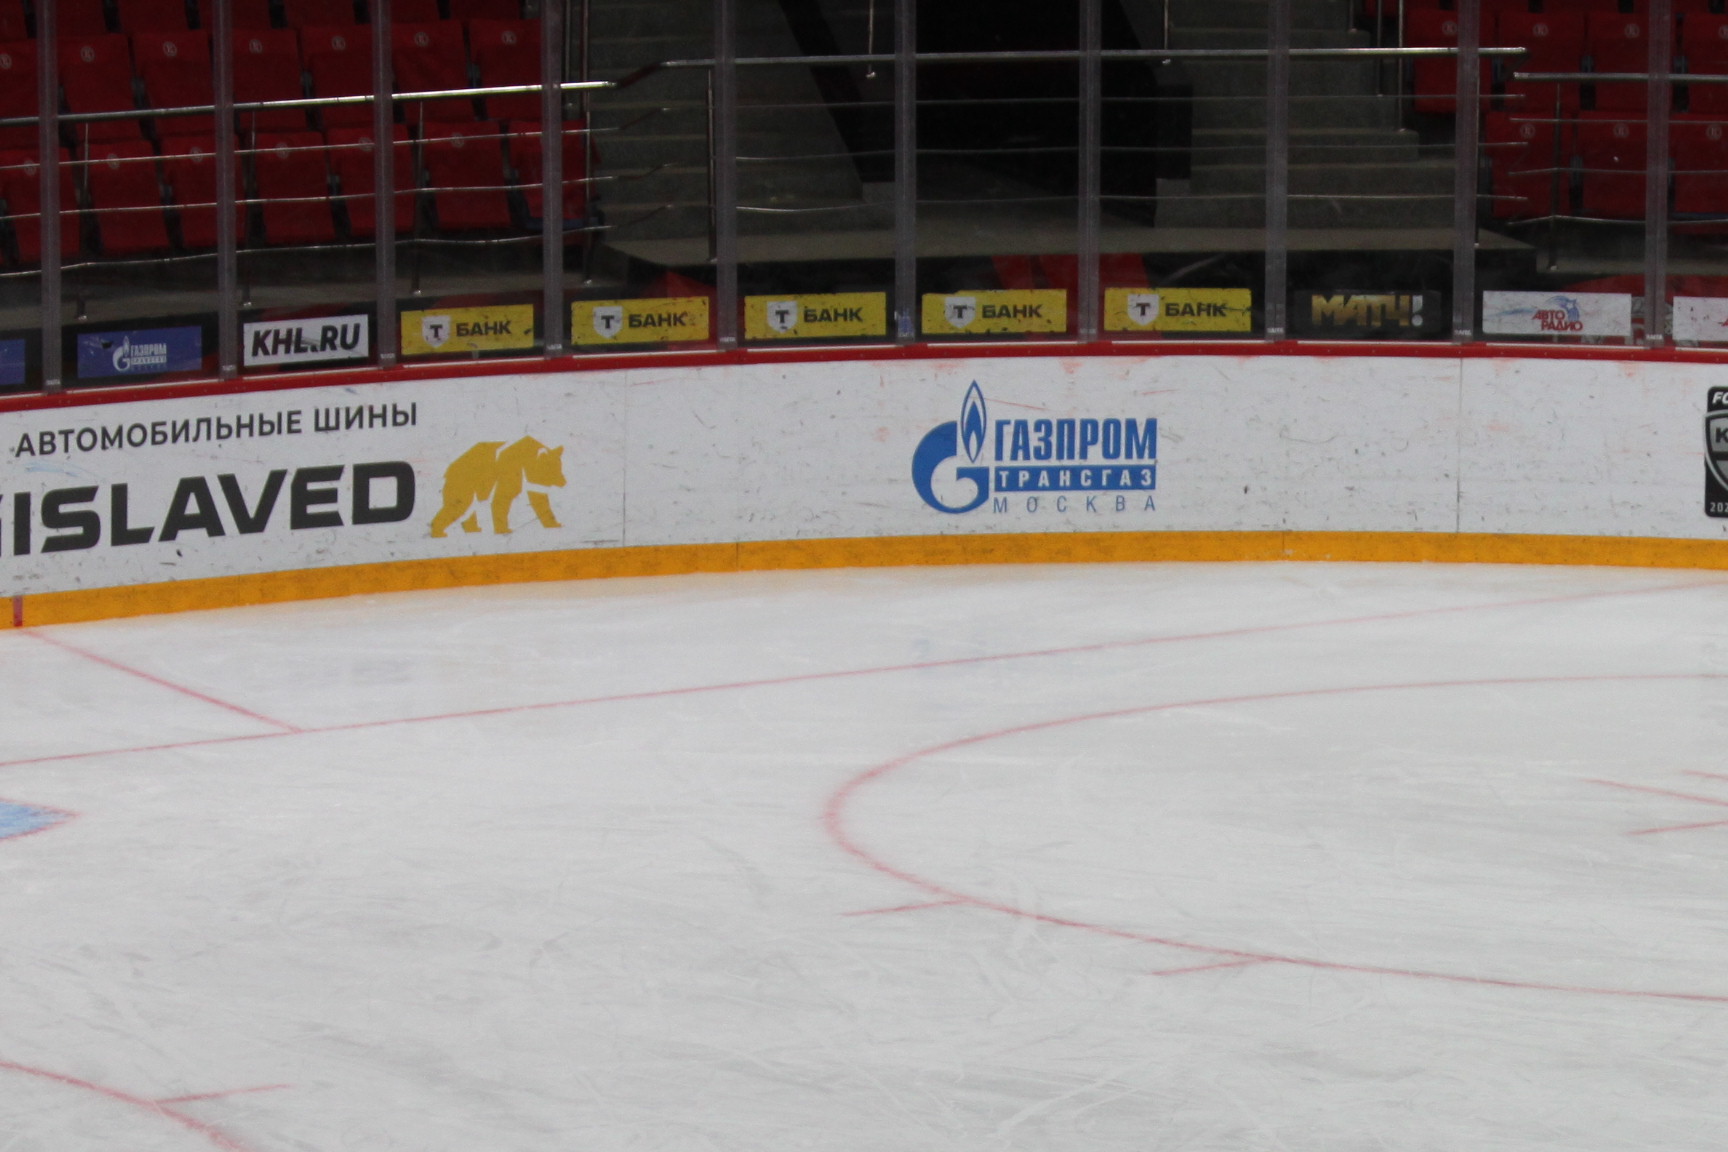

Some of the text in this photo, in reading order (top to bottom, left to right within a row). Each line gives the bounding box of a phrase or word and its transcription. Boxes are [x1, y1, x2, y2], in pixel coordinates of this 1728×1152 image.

[804, 307, 863, 323] БАНК
[982, 304, 1042, 320] БАНК
[1165, 302, 1226, 317] БАНК
[1532, 310, 1565, 321] АВТО
[628, 312, 686, 328] БАНК
[1541, 320, 1583, 332] РАДИО
[456, 321, 511, 337] БАНК
[251, 323, 361, 357] KHL.RU
[15, 402, 417, 457] АВТОМОБИЛЬНЫЕ ШИНЫ
[994, 418, 1158, 461] ГАЗПРОМ
[998, 469, 1152, 487] ТРАНСГАЗ
[0, 461, 416, 557] ISLAVED
[993, 496, 1156, 513] МОСКВА
